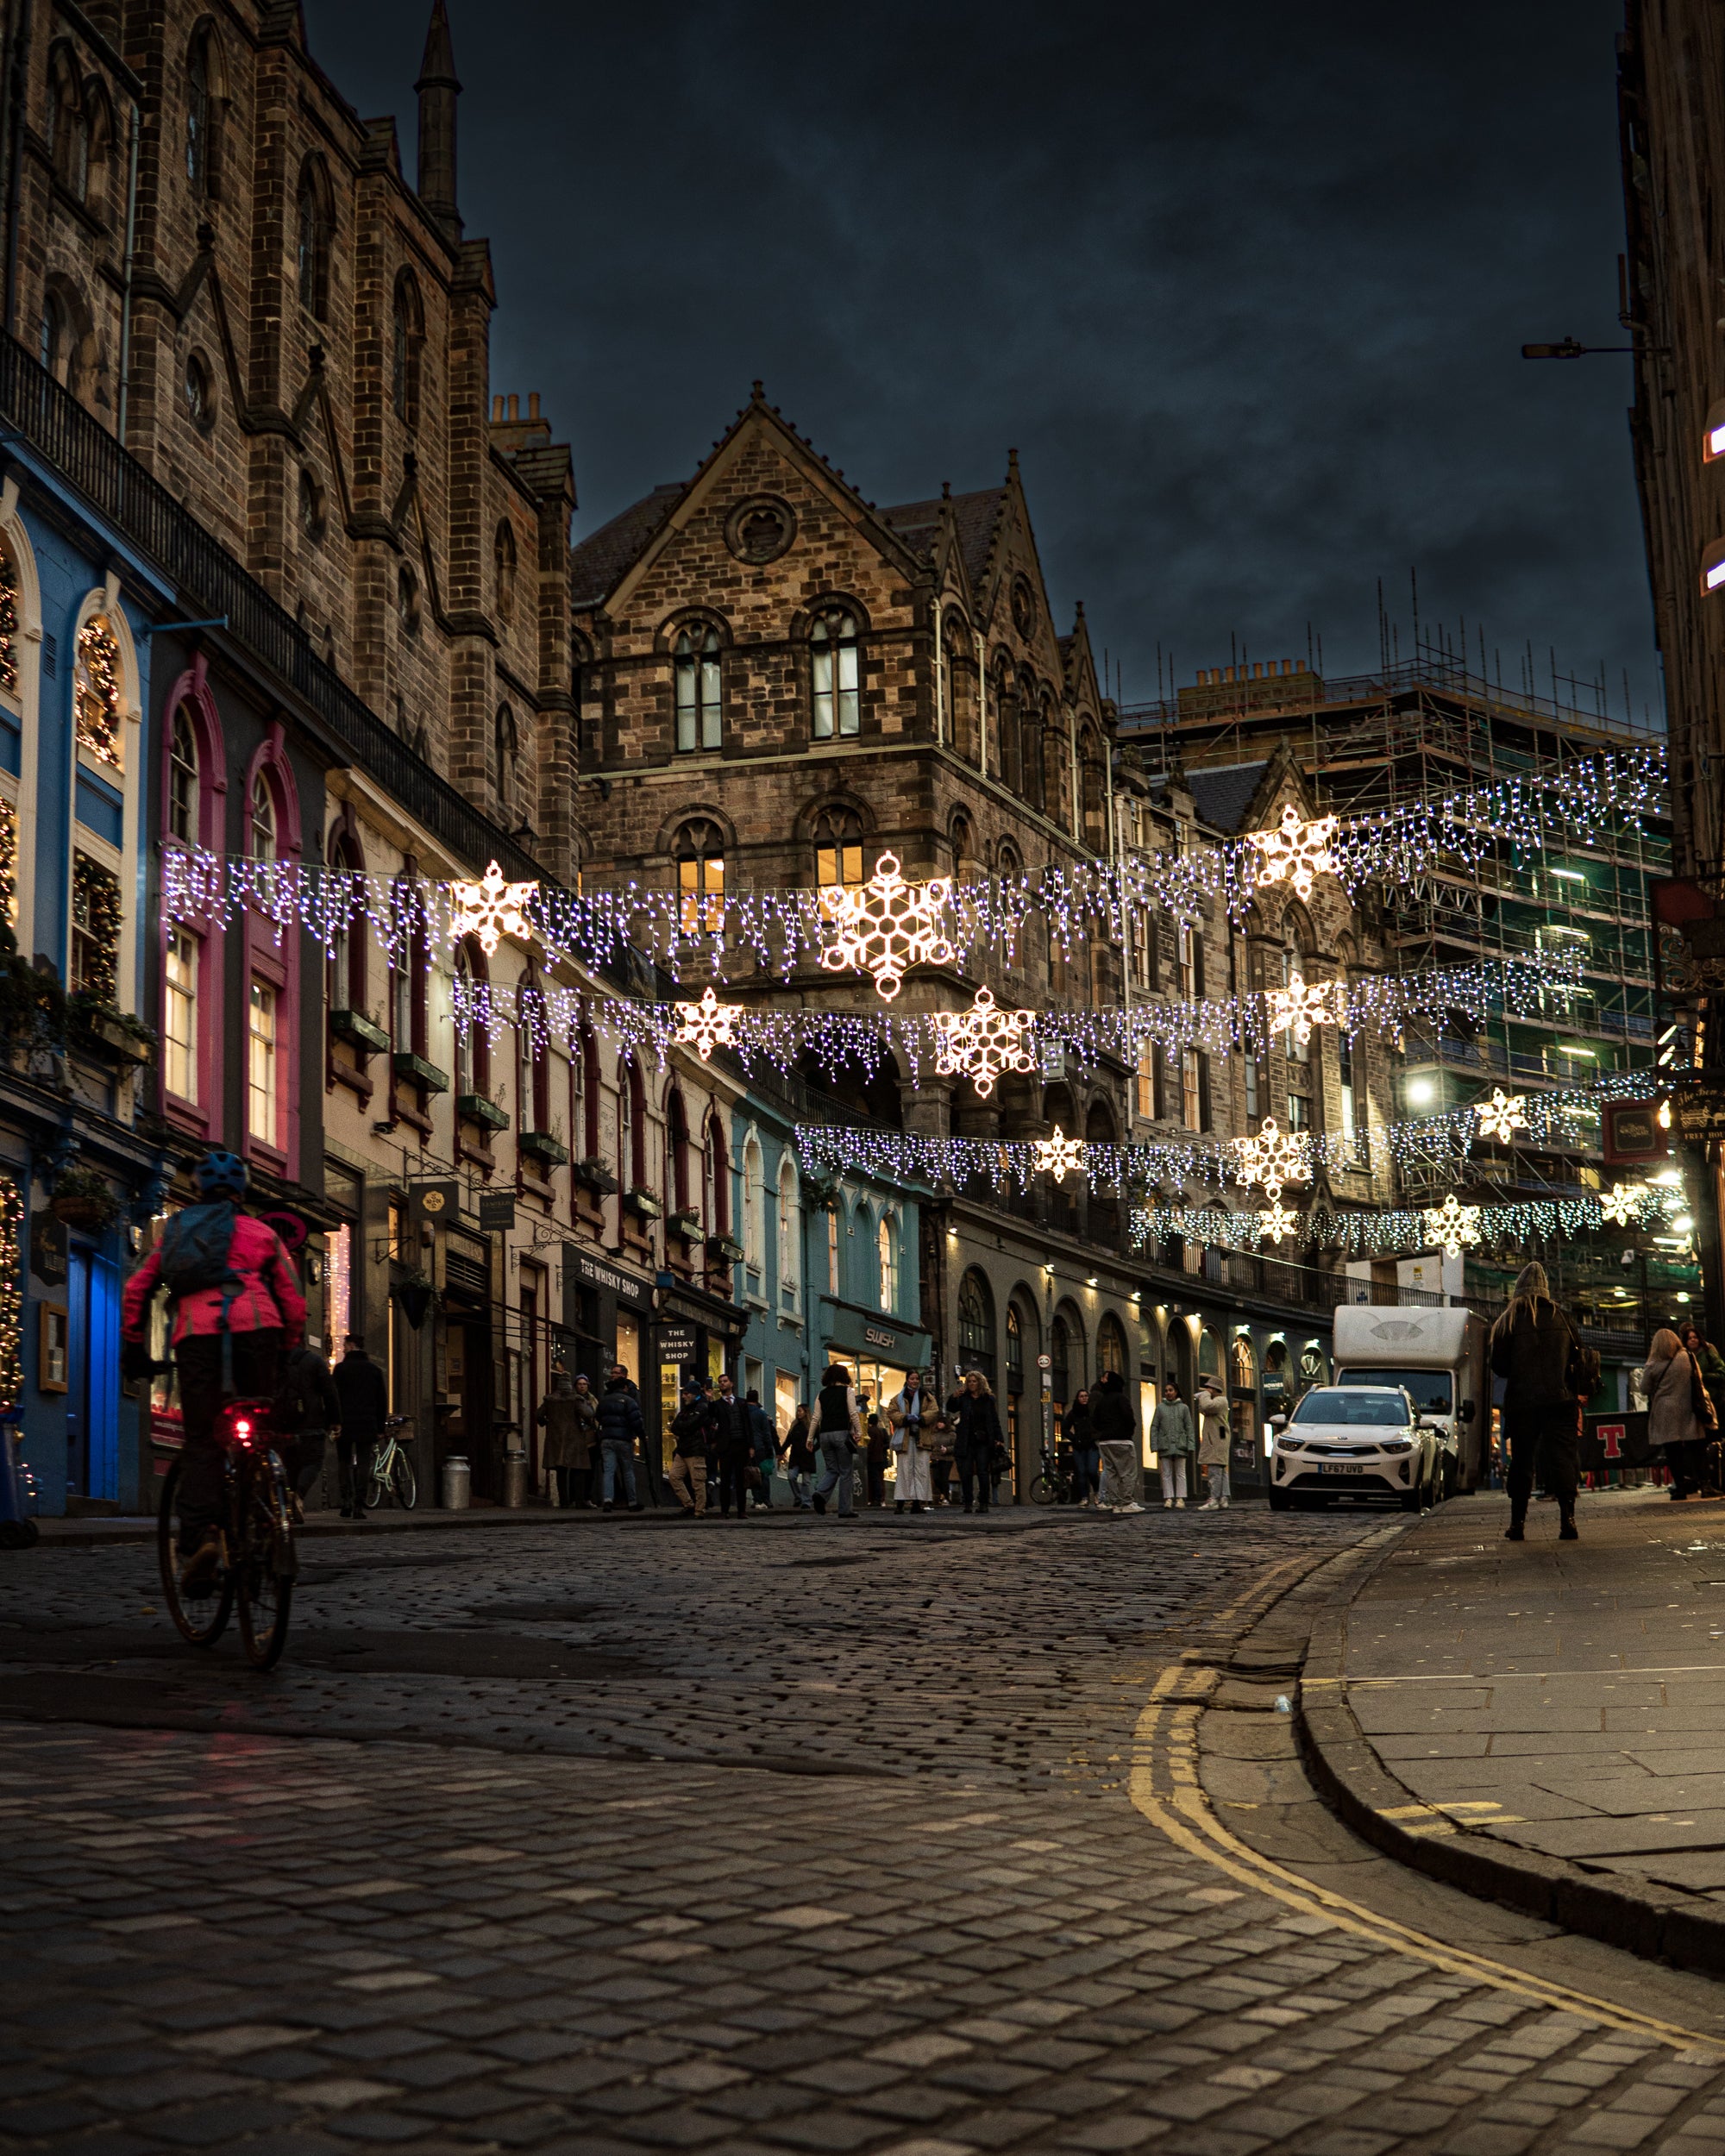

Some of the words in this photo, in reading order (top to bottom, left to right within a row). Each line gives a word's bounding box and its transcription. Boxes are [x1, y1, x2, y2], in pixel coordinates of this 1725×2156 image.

[580, 1258, 594, 1278] THE
[594, 1264, 621, 1290] WHISKY
[622, 1279, 639, 1299] SHOP
[865, 1328, 895, 1349] SWISH
[1596, 1424, 1626, 1458] T
[1323, 1464, 1345, 1473] LF67
[1346, 1465, 1364, 1474] UVD
